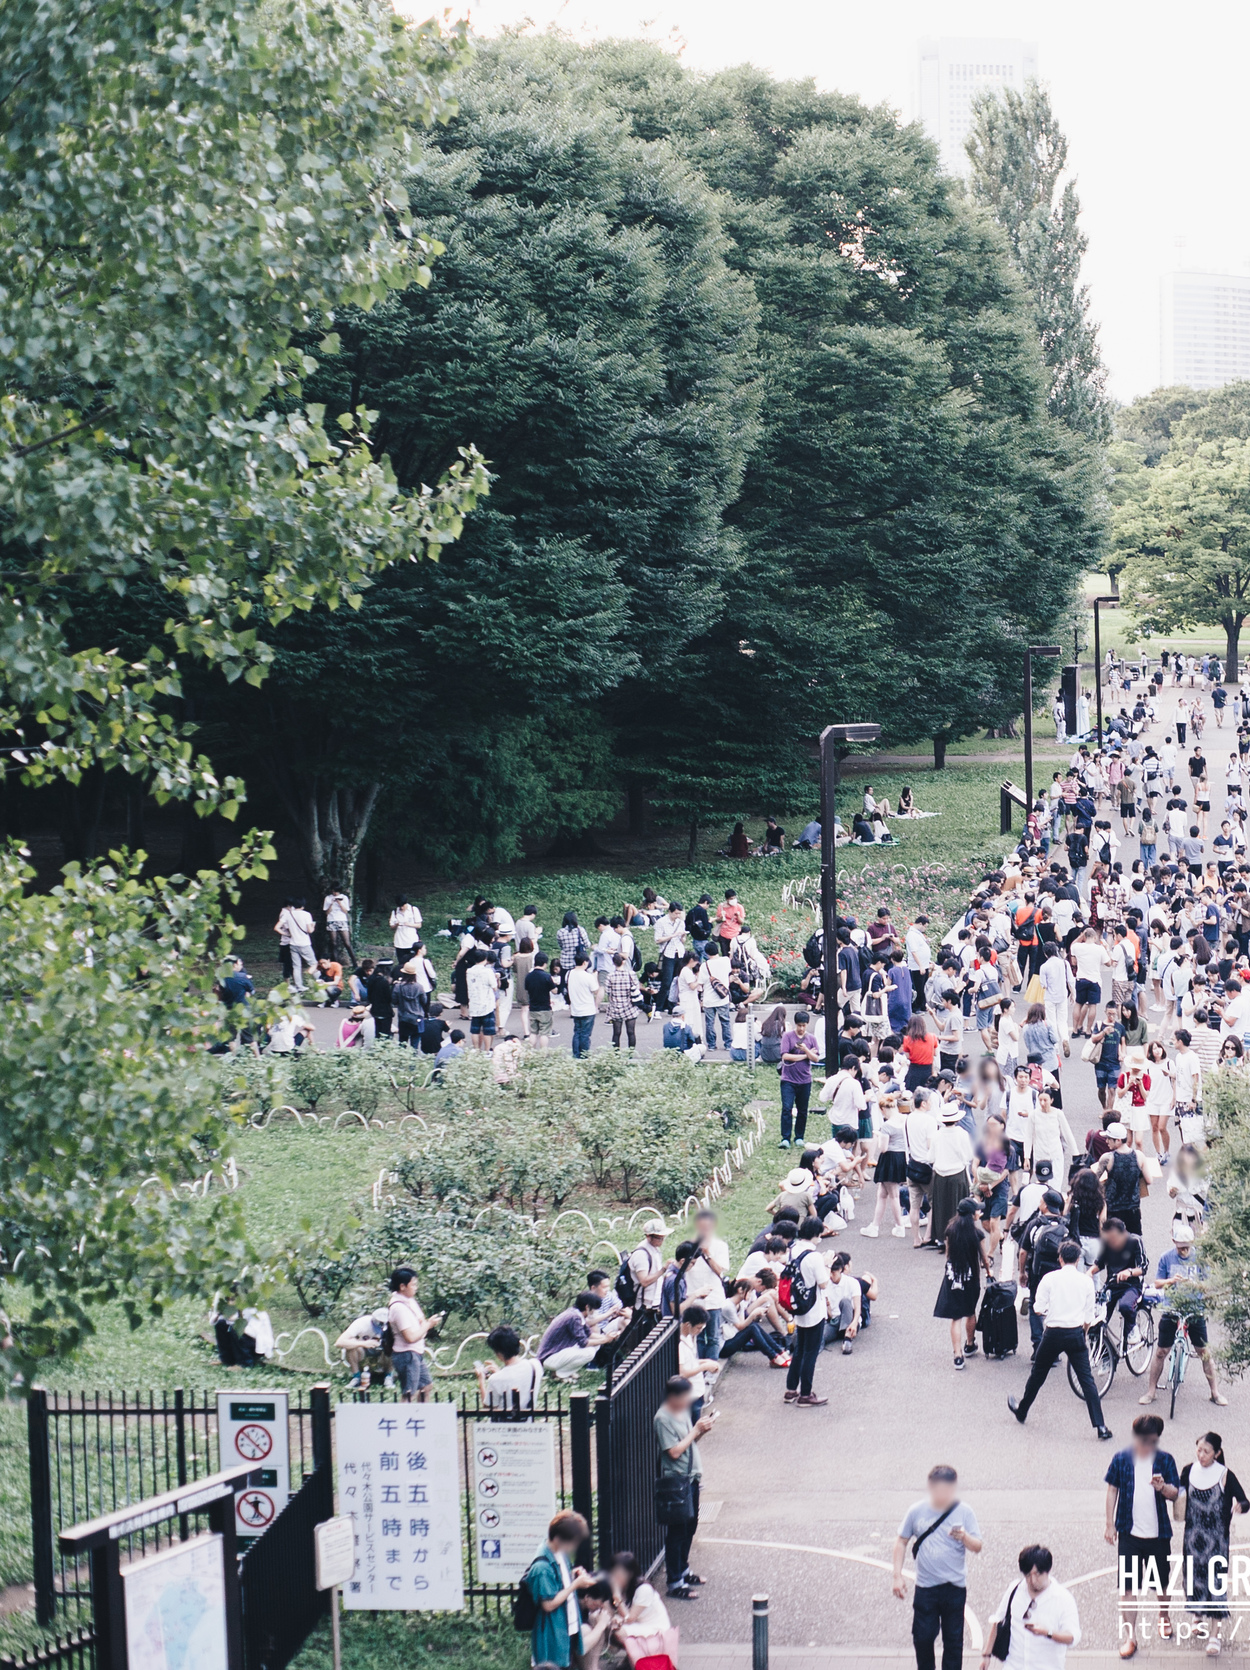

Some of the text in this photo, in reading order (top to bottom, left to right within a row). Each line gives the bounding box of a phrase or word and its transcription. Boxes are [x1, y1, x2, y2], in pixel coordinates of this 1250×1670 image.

[361, 1461, 376, 1593] 代々木公園サービスセンター
[378, 1417, 402, 1591] 午前五時まで
[405, 1417, 430, 1590] 午後五時から
